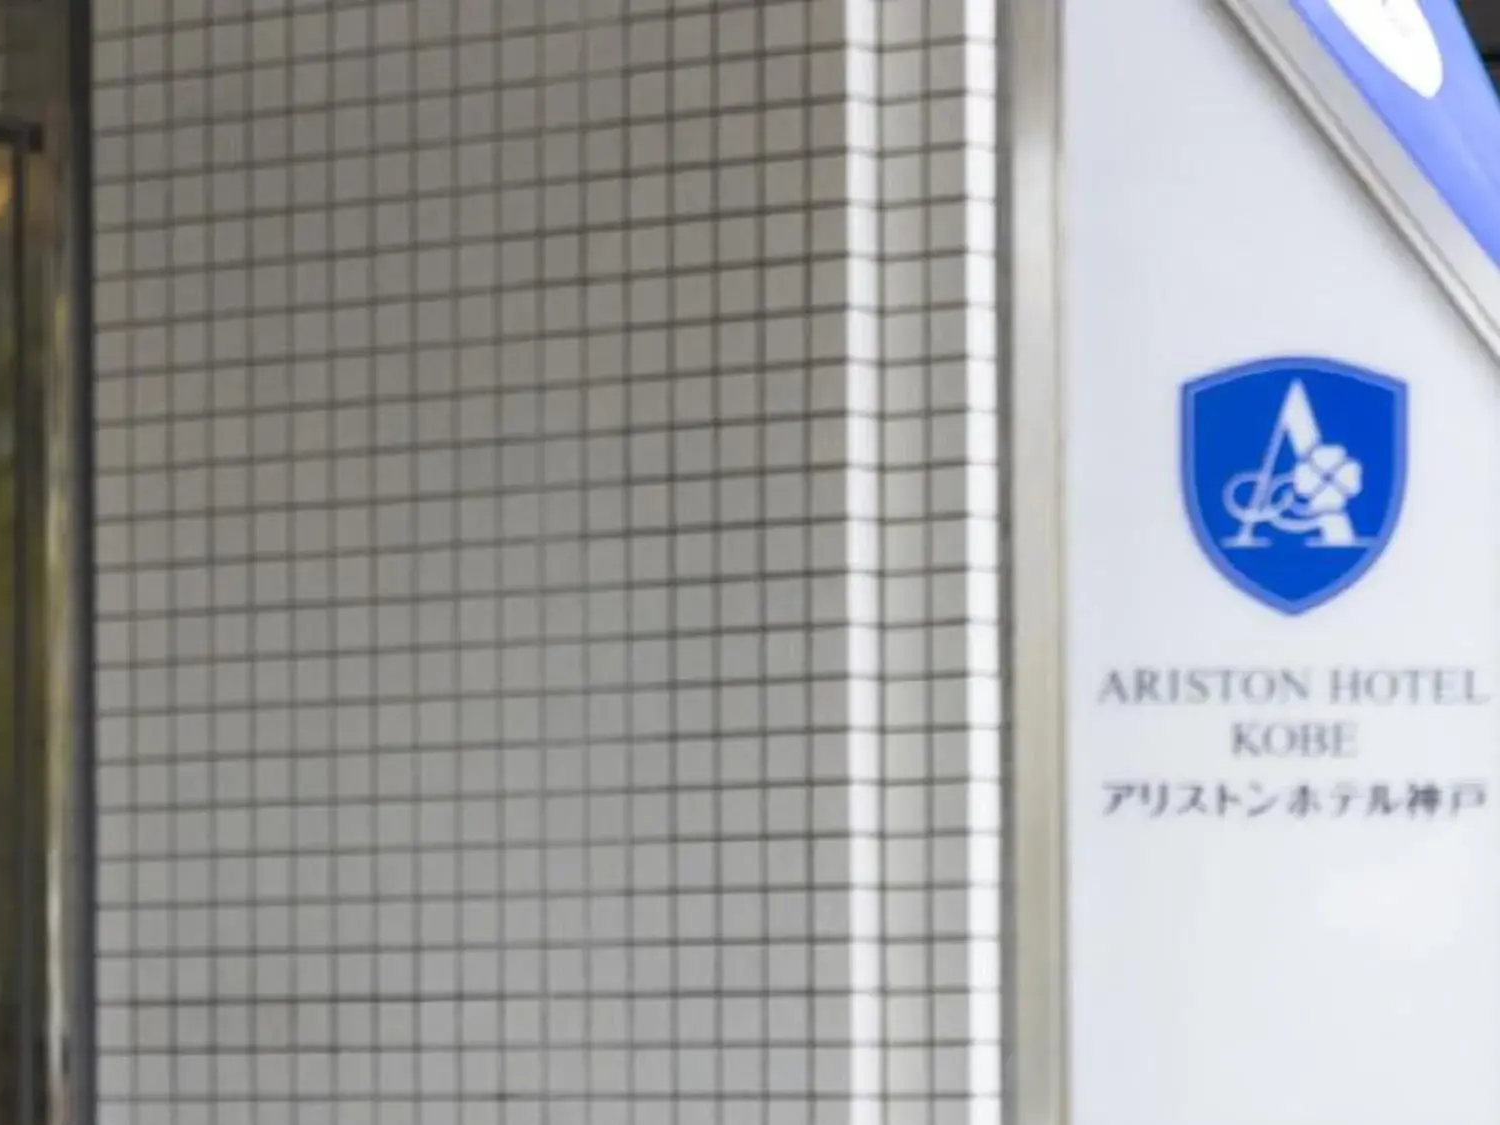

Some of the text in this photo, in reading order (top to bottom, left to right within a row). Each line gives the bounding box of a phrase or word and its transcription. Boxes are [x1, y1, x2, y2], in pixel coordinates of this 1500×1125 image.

[1097, 668, 1489, 705] ARISTON HOTEL
[1230, 722, 1357, 758] KOBE
[1102, 781, 1489, 818] アリストンホテル神戸
